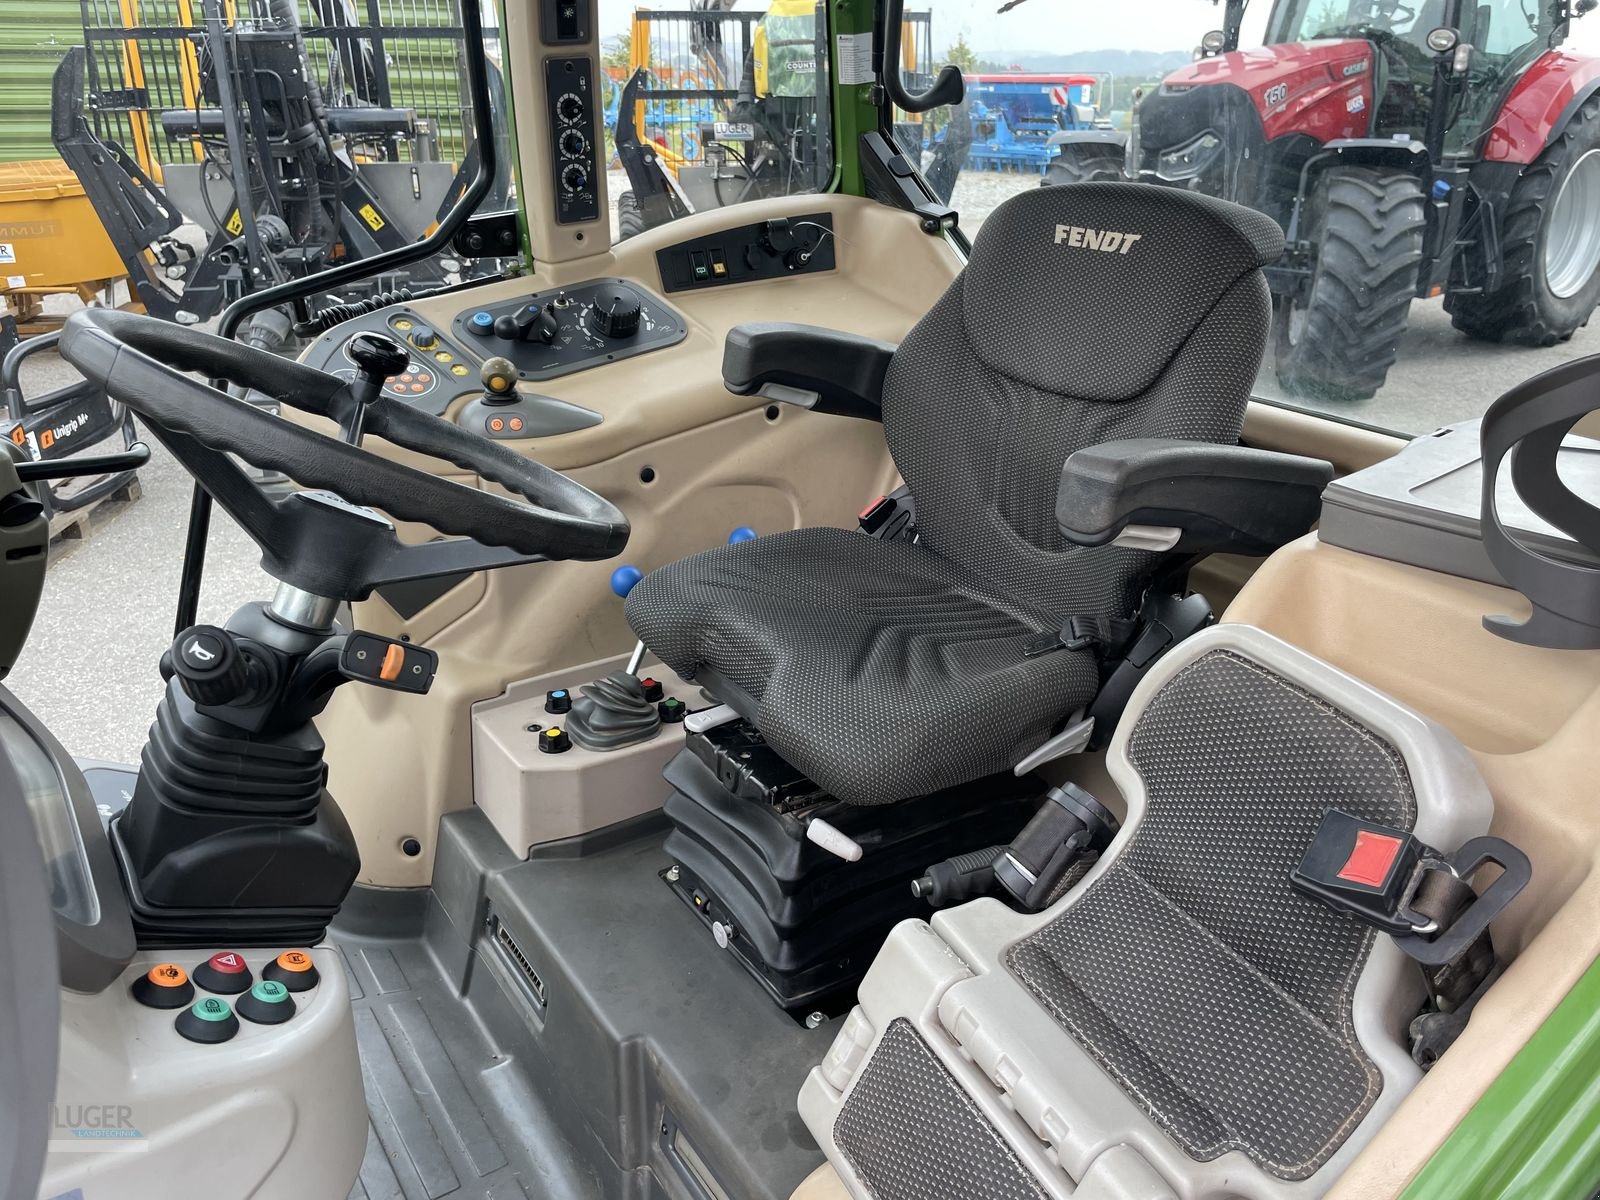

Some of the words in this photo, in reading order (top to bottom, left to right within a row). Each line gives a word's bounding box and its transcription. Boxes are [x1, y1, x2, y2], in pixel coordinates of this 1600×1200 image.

[1264, 83, 1287, 106] 150
[715, 123, 748, 134] LUGER
[1054, 223, 1142, 255] FENDT
[53, 420, 79, 440] Unigrip
